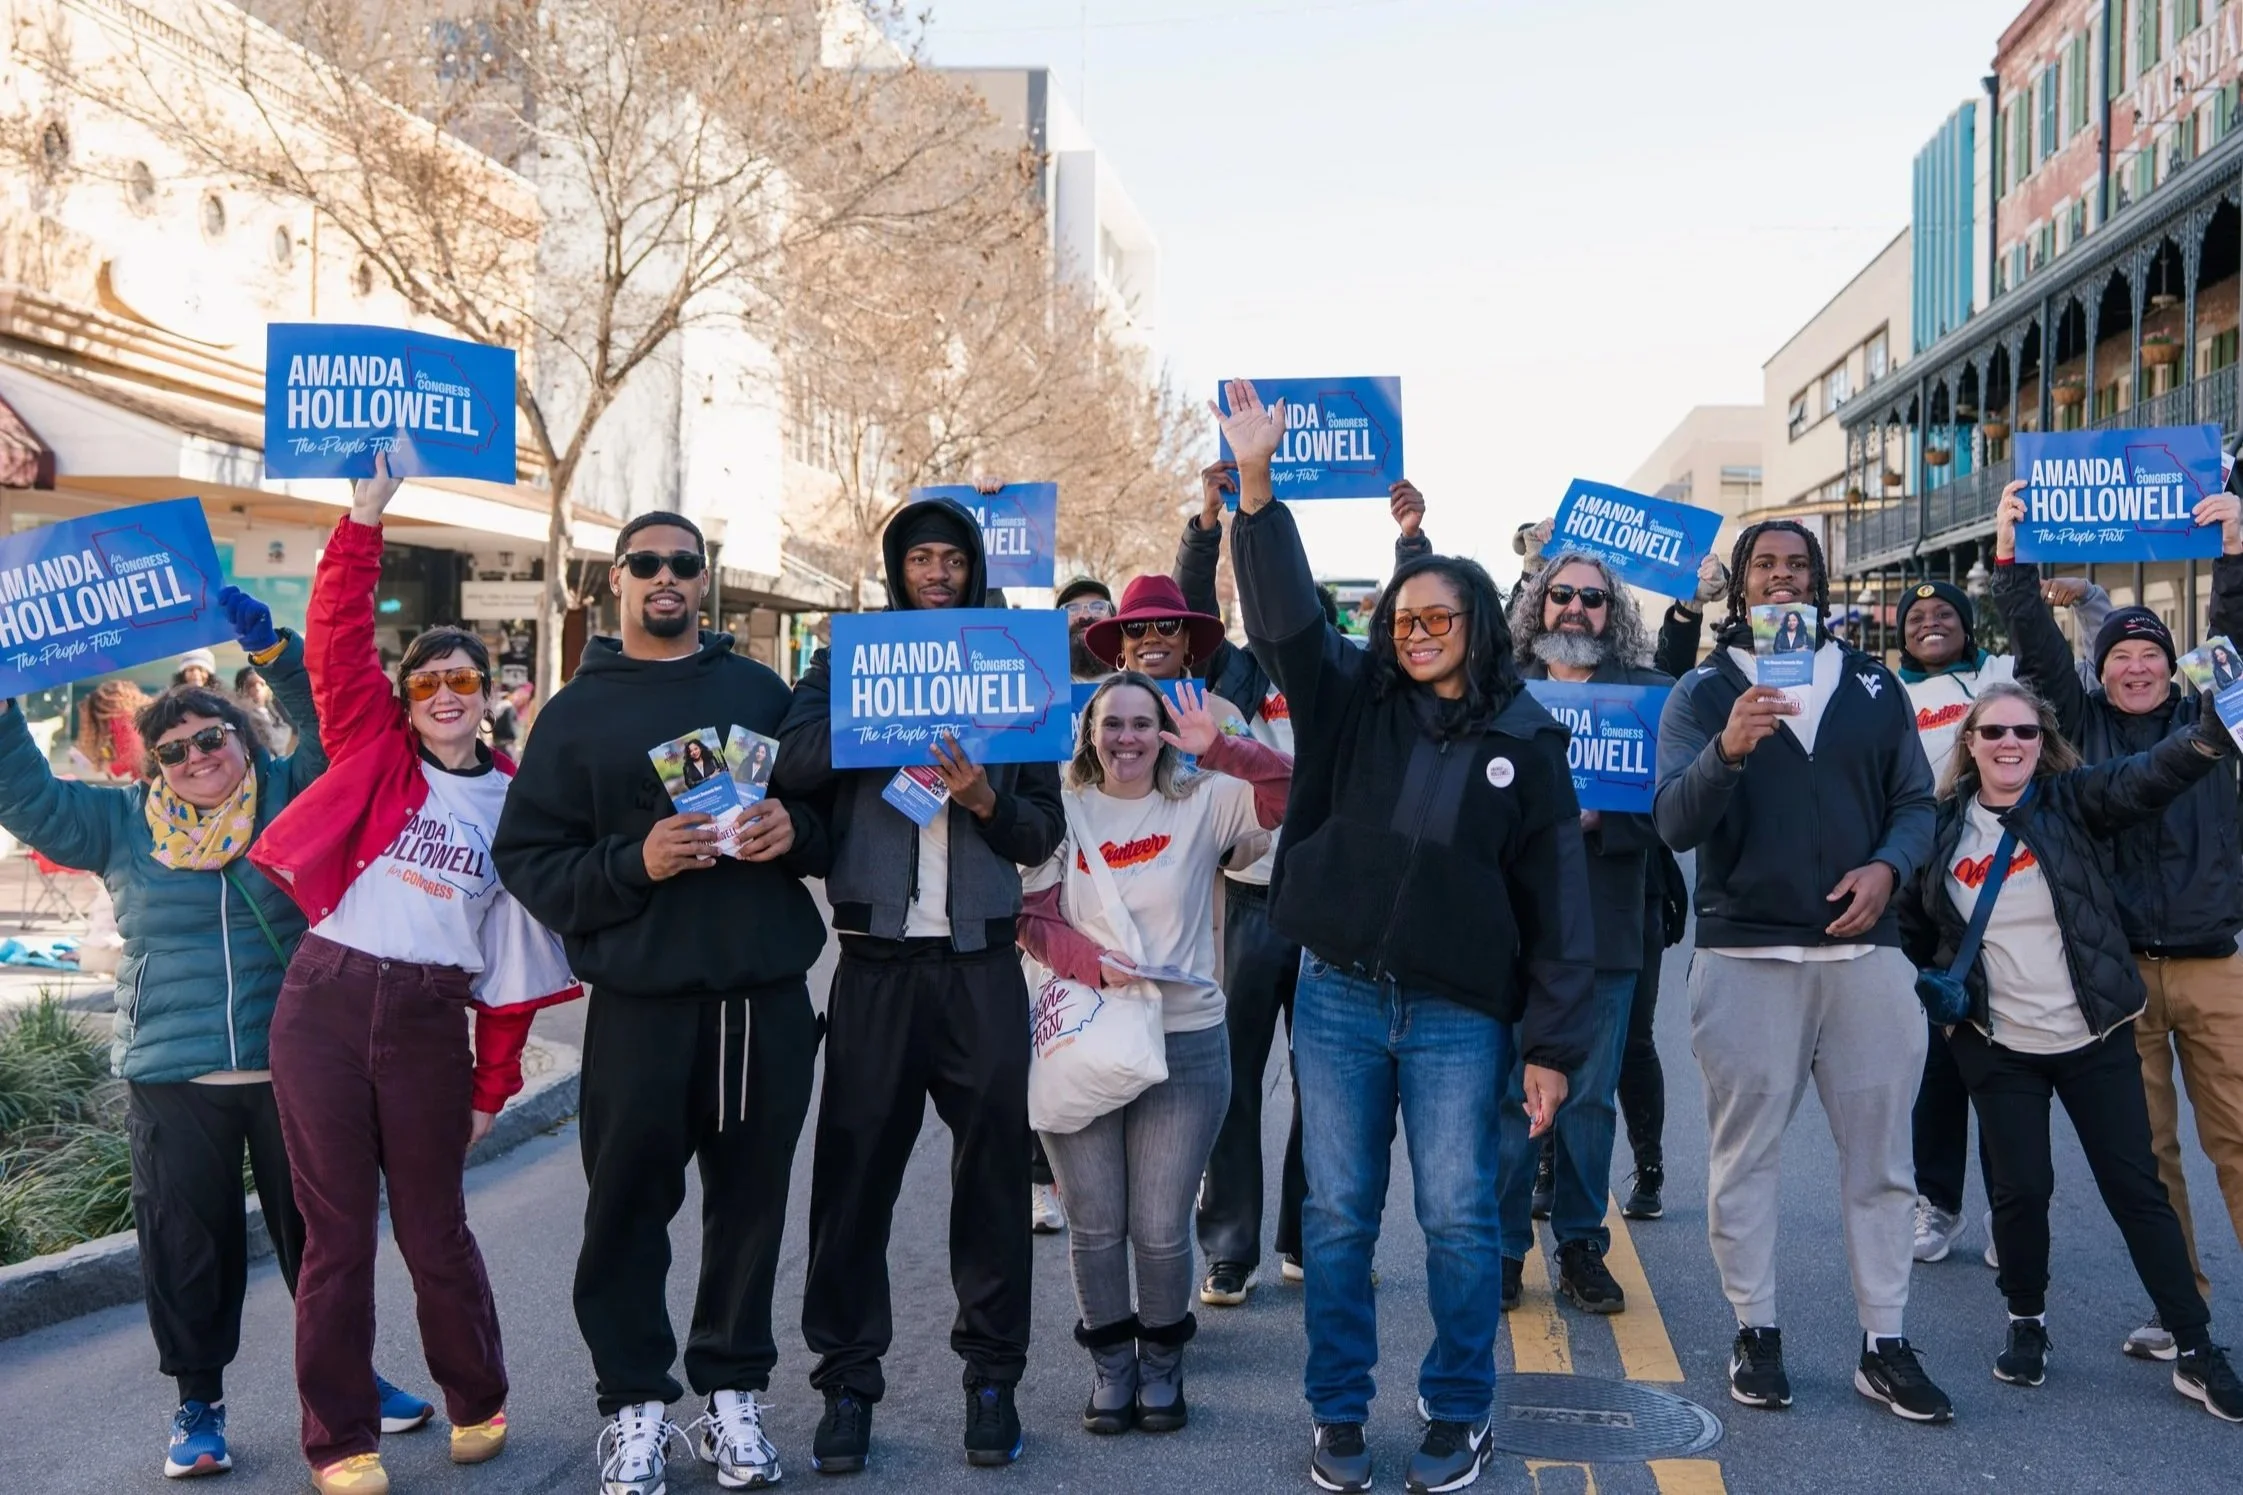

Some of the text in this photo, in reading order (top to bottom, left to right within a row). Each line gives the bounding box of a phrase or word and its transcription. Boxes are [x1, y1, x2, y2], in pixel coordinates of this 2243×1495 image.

[287, 354, 405, 388] AMANDA
[415, 369, 429, 381] for
[417, 379, 471, 398] CONGRESS
[287, 388, 480, 437] HOLLOWELL
[1328, 417, 1369, 429] CONGRESS
[288, 436, 317, 456] The
[318, 434, 368, 458] People
[1295, 467, 1328, 485] First
[2030, 457, 2127, 487] AMANDA
[2134, 464, 2146, 477] for
[2136, 472, 2183, 485] CONGRESS
[1573, 493, 1646, 529] AMANDA
[2031, 485, 2191, 523] HOLLOWELL
[1563, 508, 1682, 567] HOLLOWELL
[2032, 527, 2135, 547] The People First
[110, 553, 124, 568] for
[115, 552, 171, 576] CONGRESS
[0, 549, 104, 605] MANDA
[7, 627, 129, 673] The People First
[851, 640, 962, 676] AMANDA
[970, 650, 983, 662] for
[973, 659, 1025, 672] CONGRESS
[852, 673, 1035, 718] HOLLOWELL
[1600, 718, 1611, 728] for
[1601, 727, 1644, 739] CONGRESS
[853, 725, 881, 745] The
[881, 724, 928, 747] People
[1566, 736, 1649, 774] OWELL
[402, 868, 454, 901] CONGRESS
